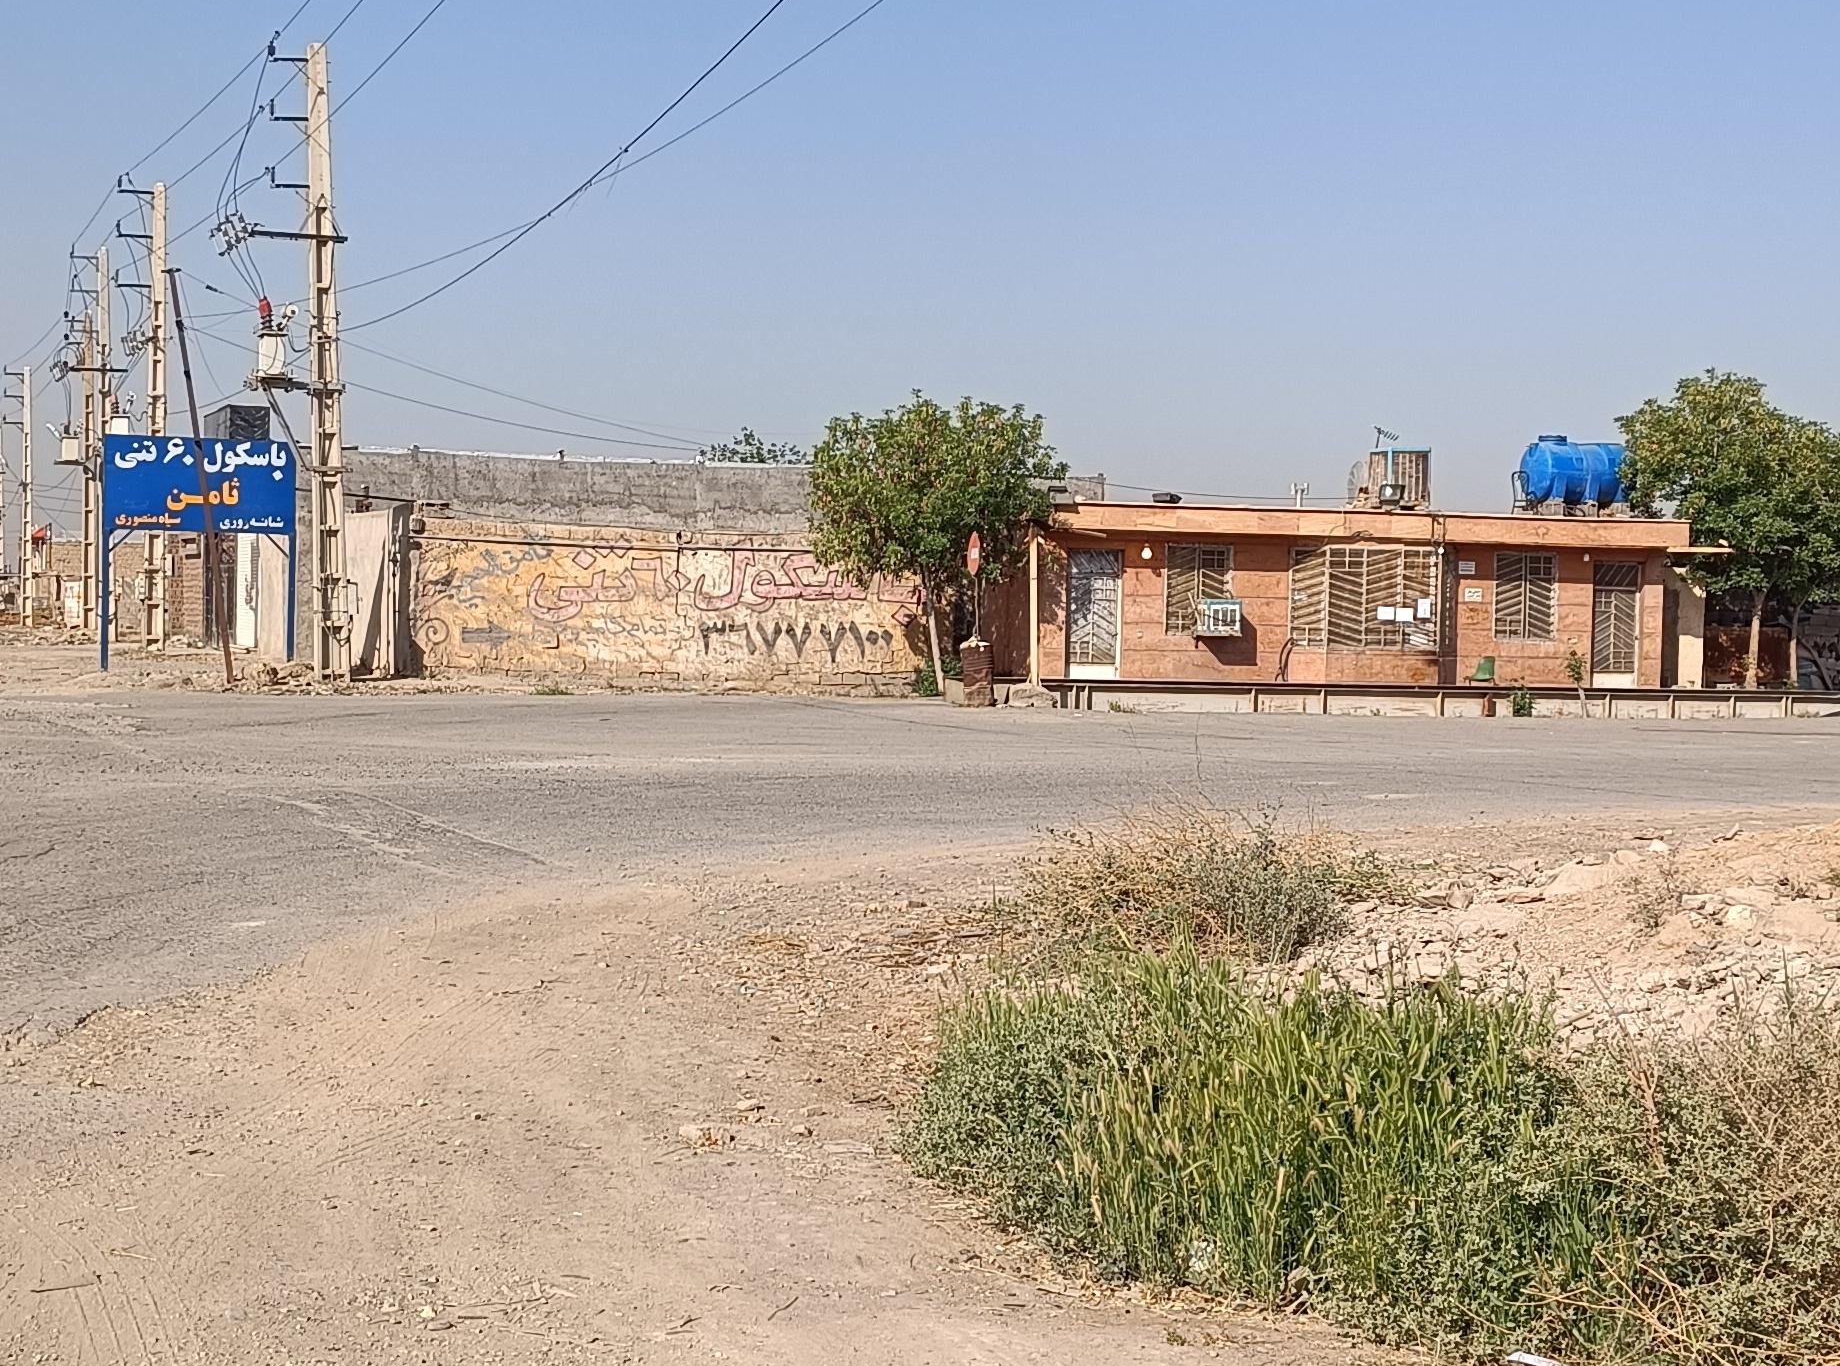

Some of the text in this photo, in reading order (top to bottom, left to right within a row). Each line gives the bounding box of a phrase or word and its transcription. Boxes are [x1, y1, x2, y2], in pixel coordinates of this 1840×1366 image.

[114, 438, 287, 481] باسکول ۶۰ تنی
[166, 477, 240, 511] ثامن
[115, 513, 158, 526] منصوری
[528, 536, 637, 624] تنی
